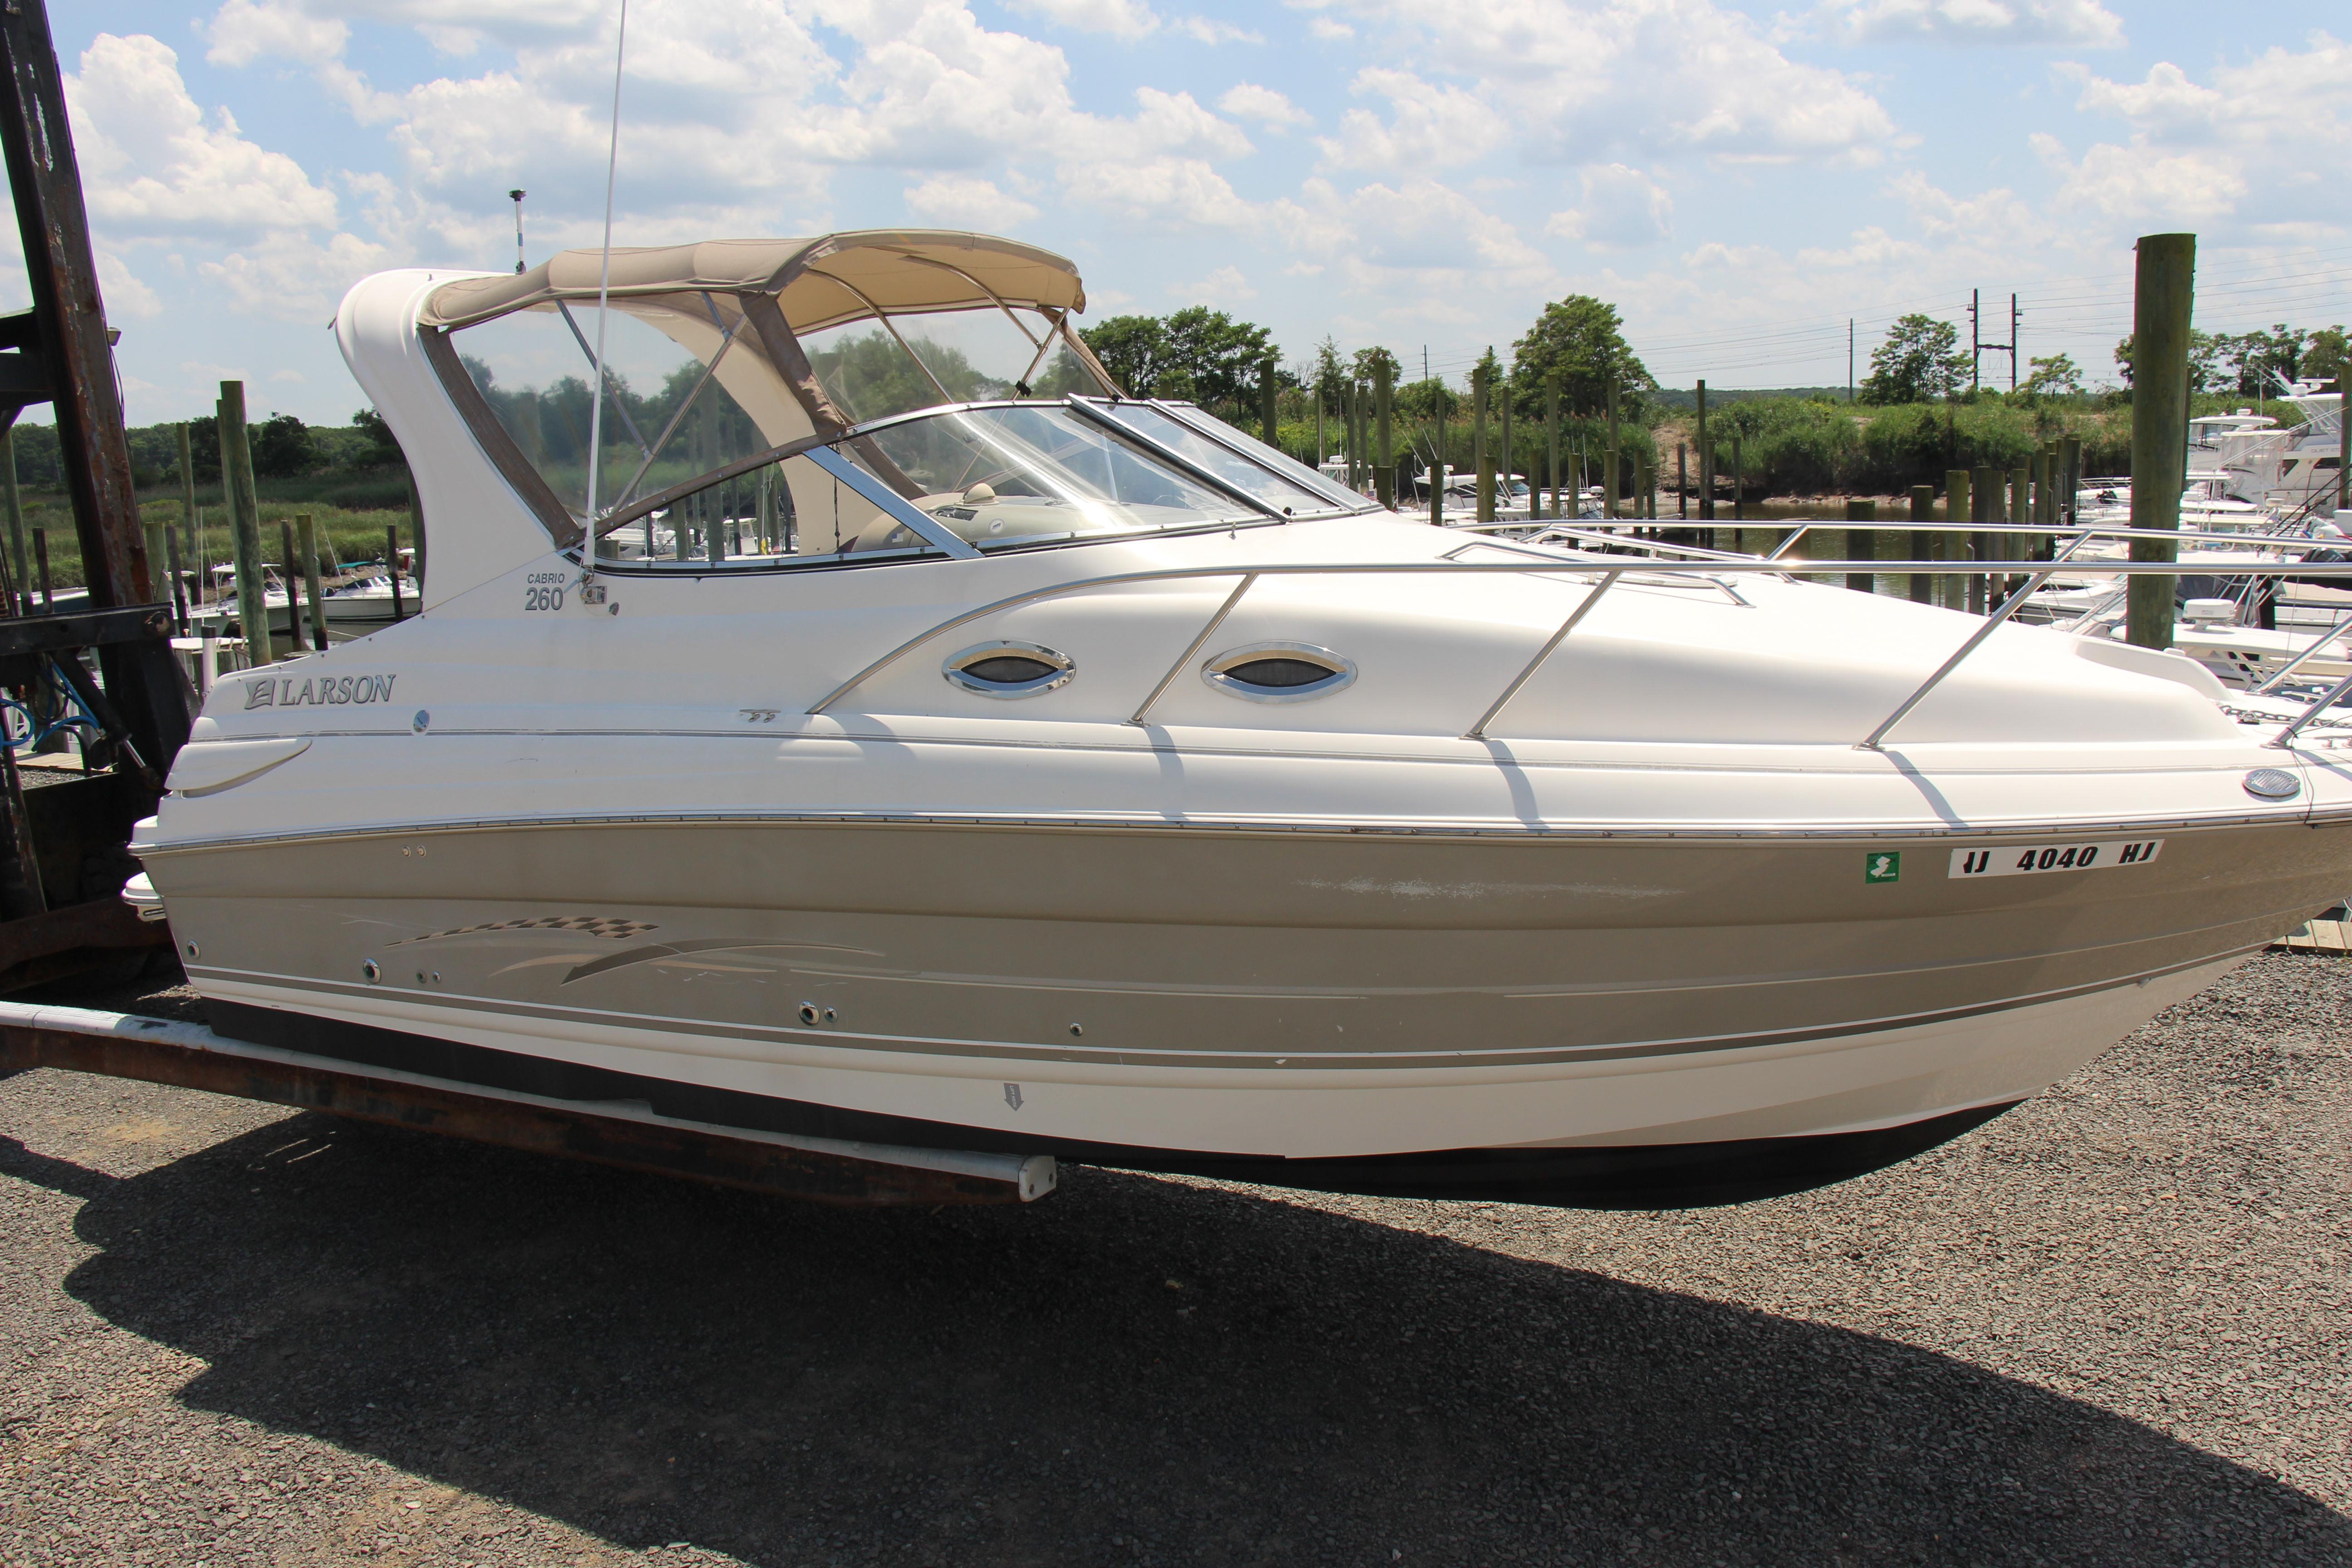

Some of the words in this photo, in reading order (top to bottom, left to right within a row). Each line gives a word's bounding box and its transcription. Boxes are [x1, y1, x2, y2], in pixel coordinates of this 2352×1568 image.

[527, 573, 565, 584] CABRIO
[525, 587, 563, 610] 260
[279, 674, 396, 706] LARSON
[2016, 846, 2098, 871] 4040
[2118, 842, 2156, 864] HJ
